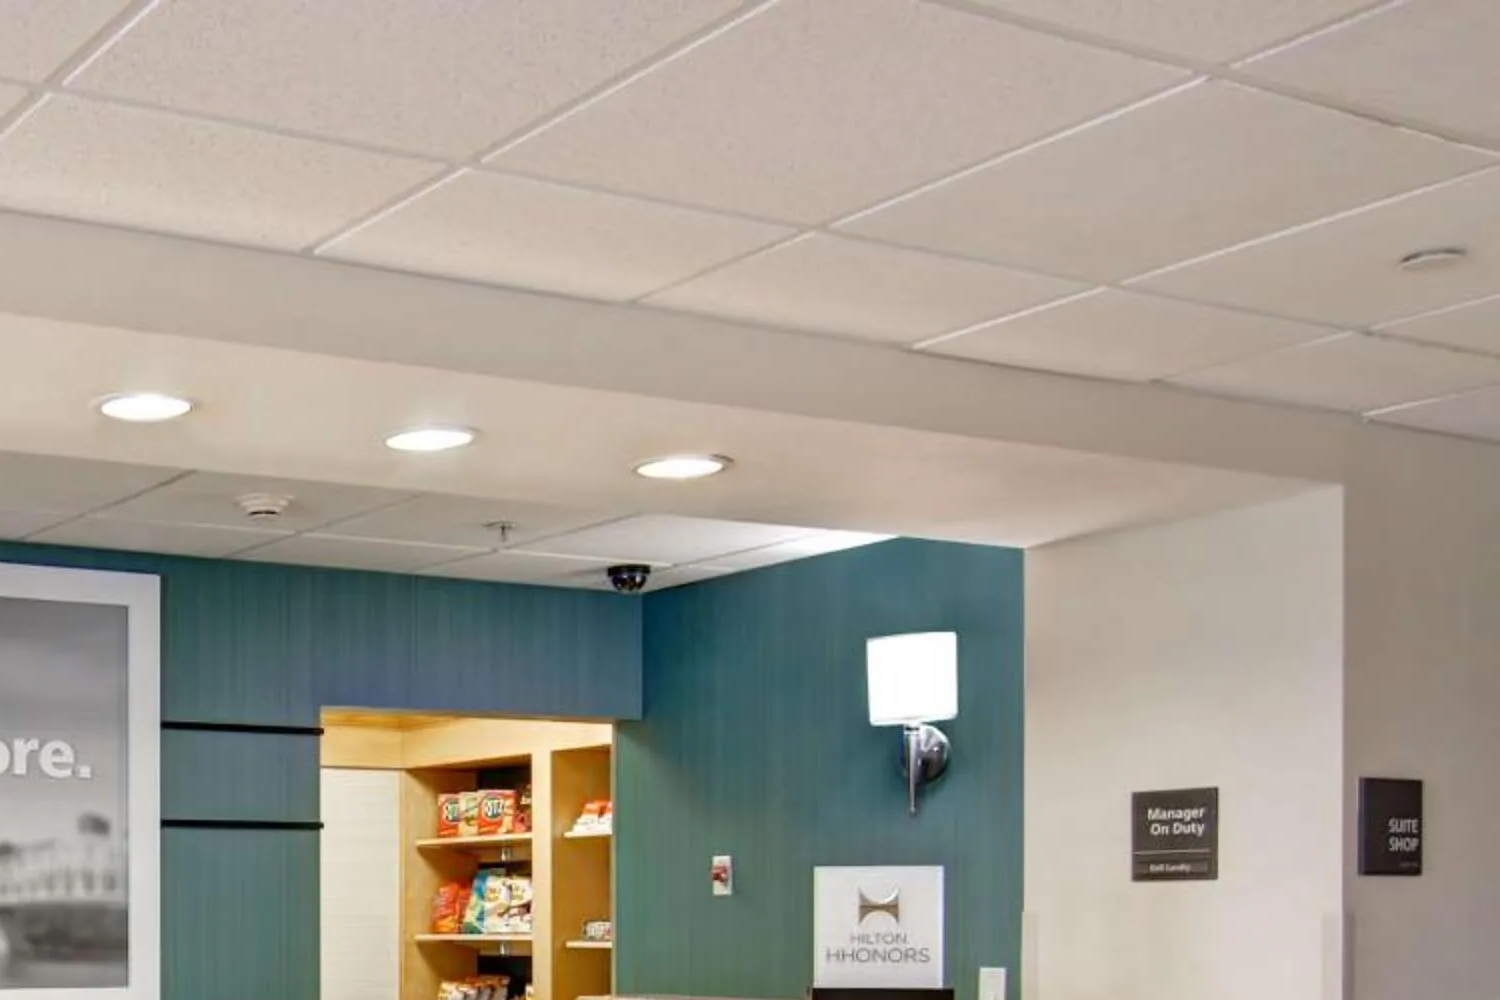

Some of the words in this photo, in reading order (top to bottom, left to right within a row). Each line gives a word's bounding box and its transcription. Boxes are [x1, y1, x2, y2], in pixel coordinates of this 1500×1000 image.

[1147, 807, 1206, 822] Manager
[1150, 823, 1169, 835] On
[1172, 822, 1205, 837] Duty
[1388, 818, 1419, 833] SUITE
[1388, 836, 1419, 852] SHOP
[850, 932, 907, 945] HILTON
[826, 947, 931, 963] HHONORS
